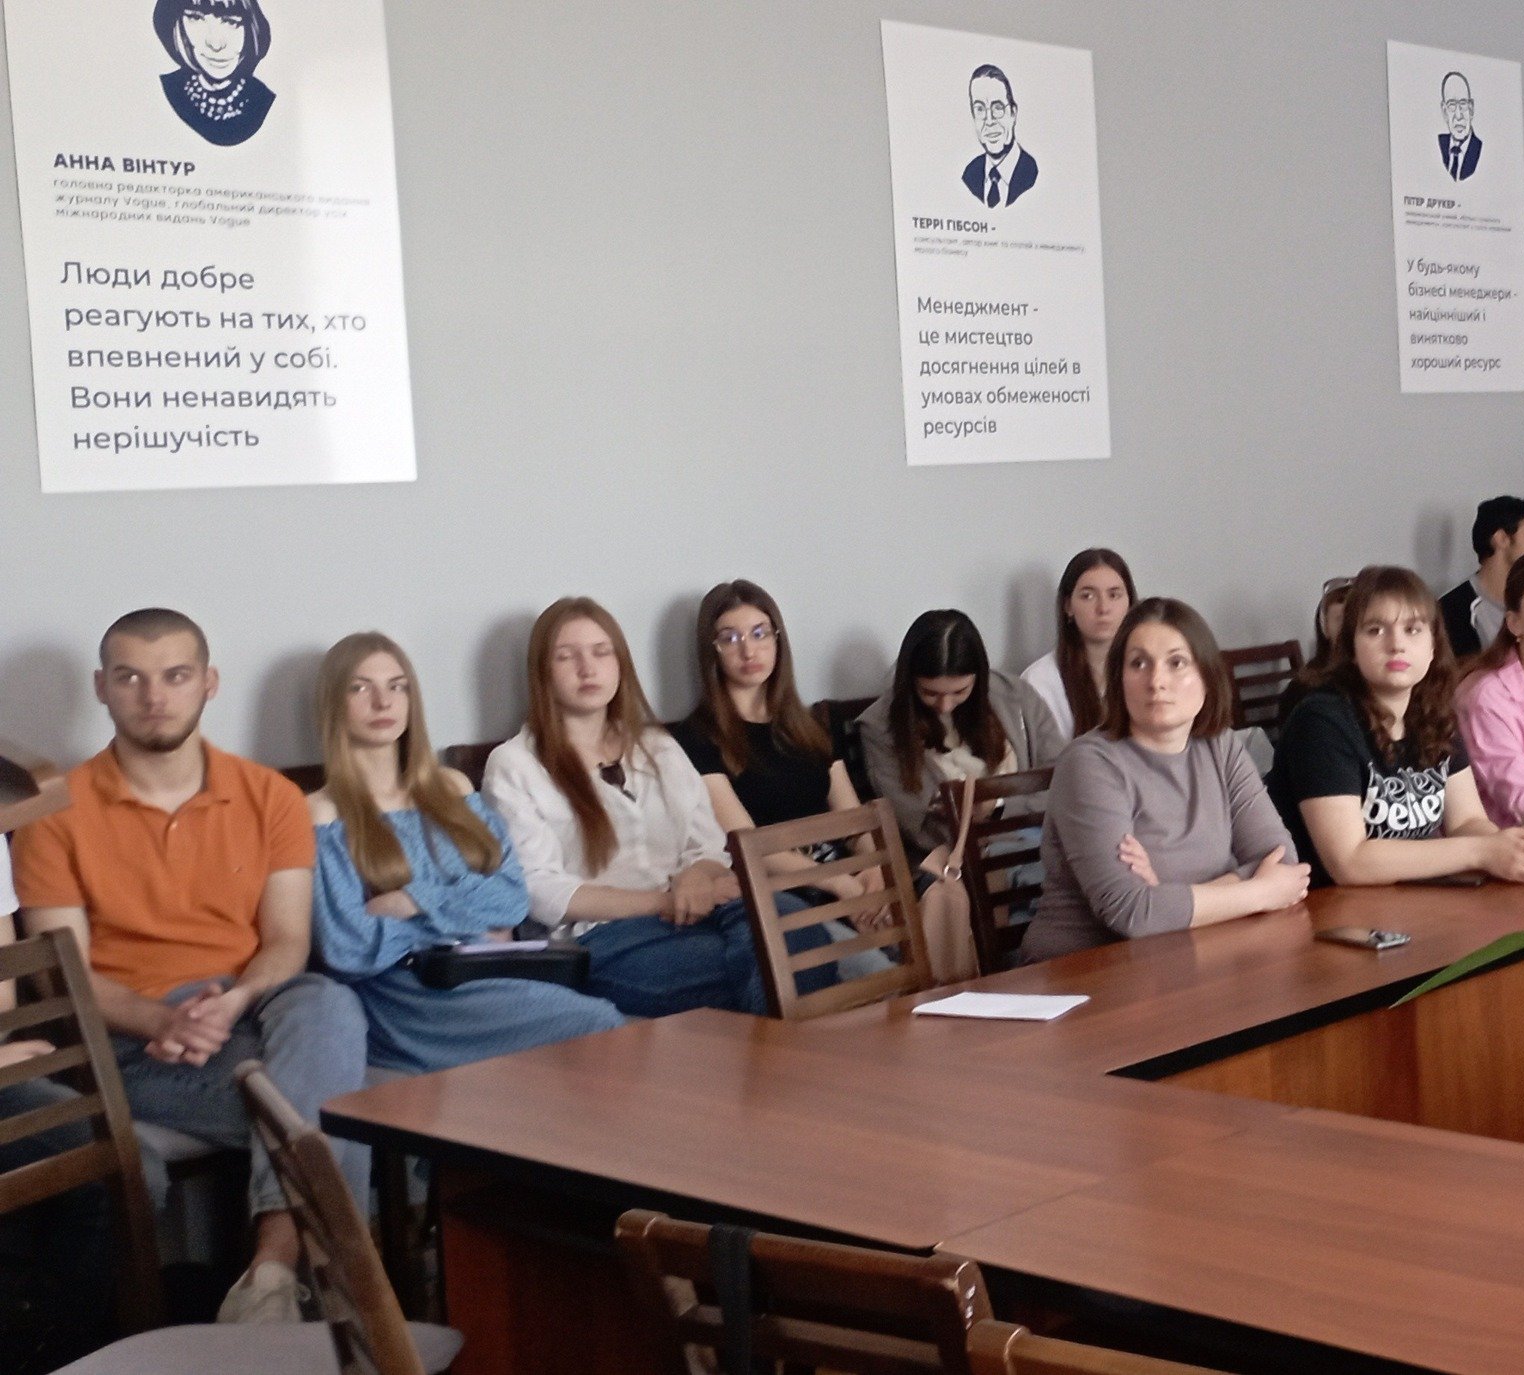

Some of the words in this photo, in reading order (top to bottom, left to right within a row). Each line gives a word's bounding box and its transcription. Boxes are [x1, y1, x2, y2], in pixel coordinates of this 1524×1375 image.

[53, 153, 115, 172] АННА
[122, 158, 196, 177] ВІНТУР
[912, 216, 943, 231] ТЕРРІ
[60, 262, 150, 288] Люди
[161, 265, 255, 293] добре
[917, 297, 1028, 317] Менеджмент
[64, 307, 212, 333] реагують
[220, 312, 253, 329] на
[263, 311, 316, 334] тих,
[324, 312, 367, 332] хто
[919, 330, 940, 346] це
[945, 331, 1033, 347] мистецтво
[68, 346, 241, 369] впевнений
[249, 349, 266, 373] у
[274, 346, 338, 370] собі.
[920, 361, 1020, 377] досягнення
[1024, 357, 1068, 376] цілей
[1073, 361, 1081, 374] в
[71, 386, 150, 409] Вони
[163, 389, 337, 410] ненавидять
[921, 390, 983, 409] умовах
[986, 386, 1090, 404] обмеженості
[923, 416, 997, 438] ресурсів
[73, 425, 259, 454] нерішучість
